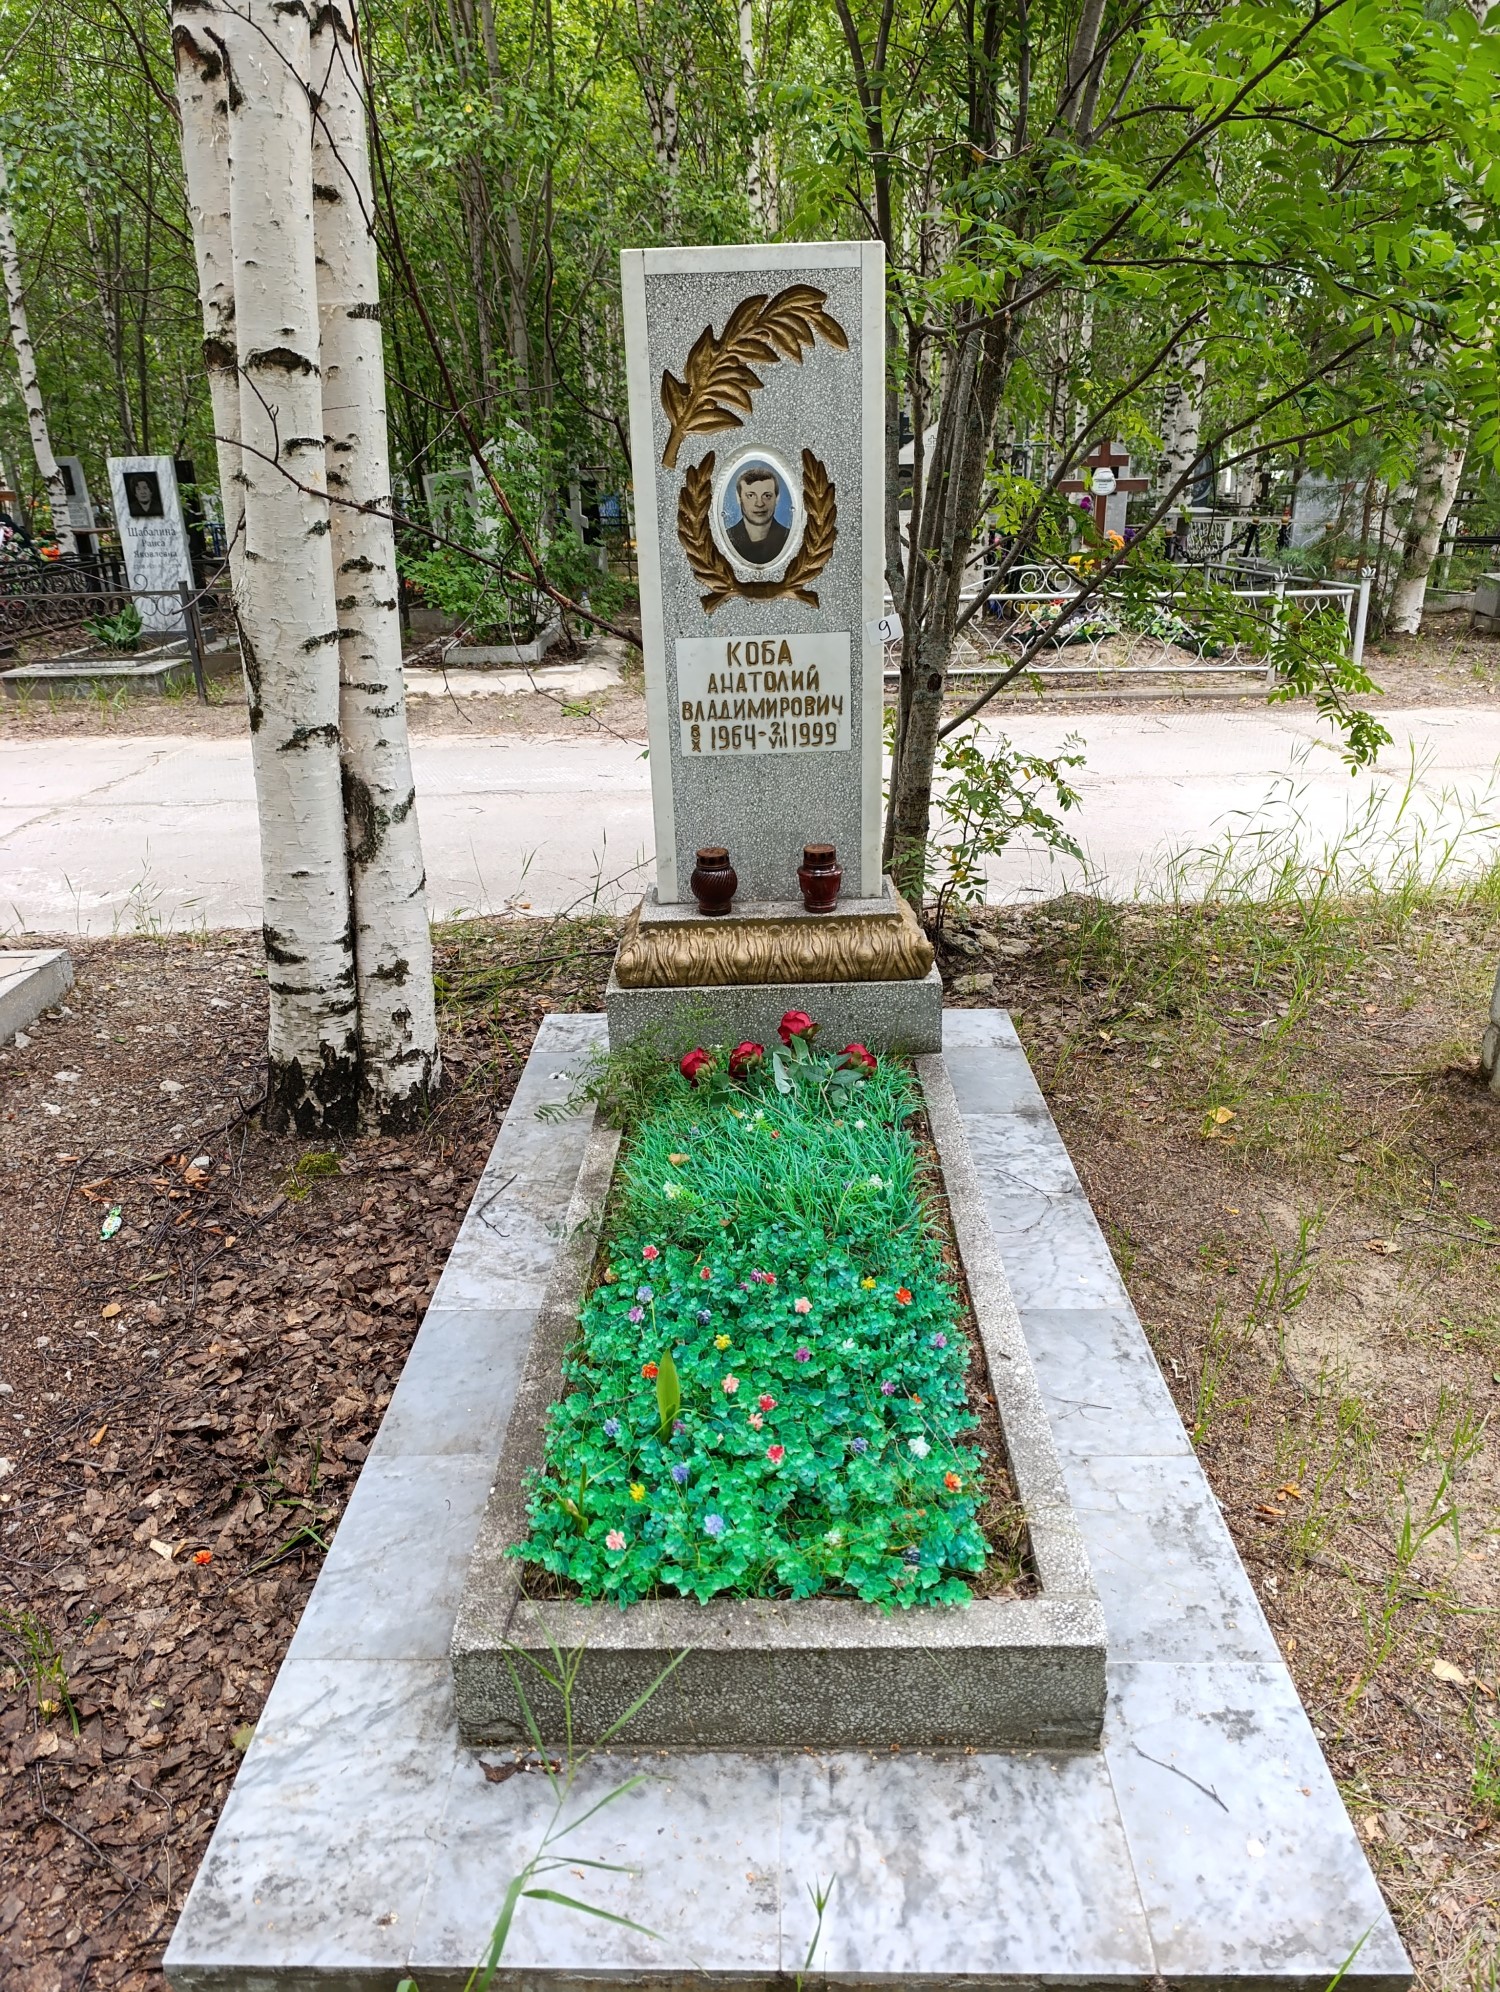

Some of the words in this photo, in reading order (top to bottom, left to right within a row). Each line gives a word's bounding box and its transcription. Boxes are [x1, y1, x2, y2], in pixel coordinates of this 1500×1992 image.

[128, 527, 176, 537] Шабалина
[878, 619, 892, 641] 9
[726, 639, 793, 668] КОБА
[707, 664, 820, 694] АНАТОЛИЙ
[682, 694, 843, 722] ВЛАДИМИРОВИЧ
[792, 722, 838, 748] 1999
